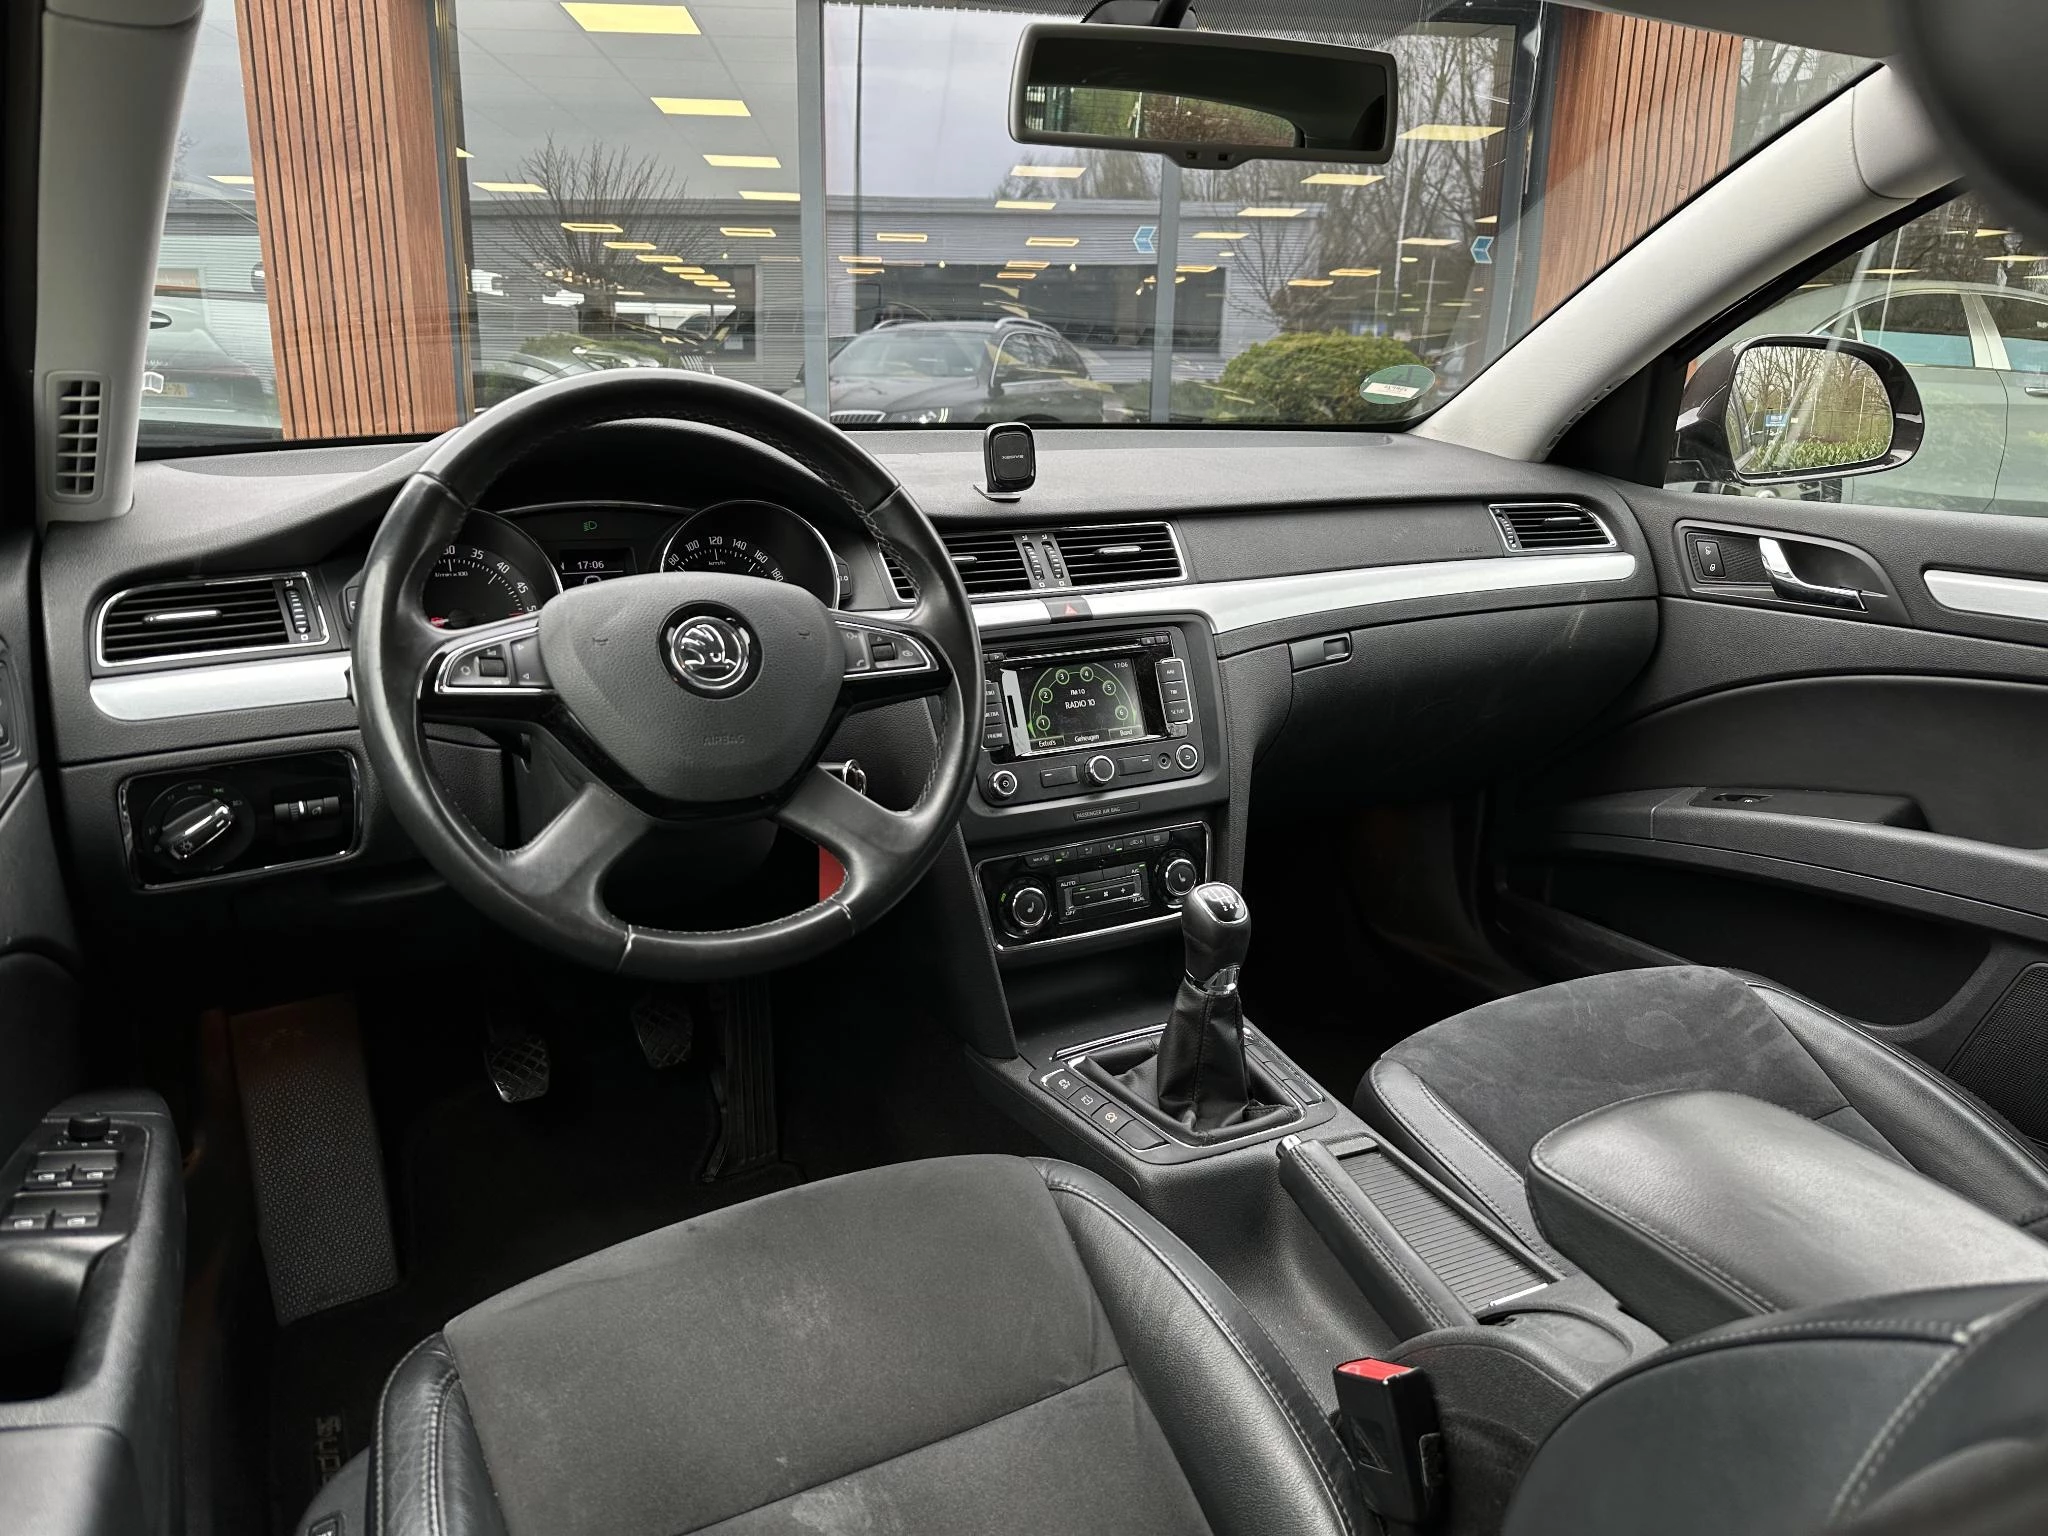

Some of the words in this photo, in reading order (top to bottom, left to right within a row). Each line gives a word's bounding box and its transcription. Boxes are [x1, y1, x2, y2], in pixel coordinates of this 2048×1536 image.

[684, 539, 700, 552] 100
[708, 536, 723, 545] 120
[732, 538, 747, 551] 140
[471, 548, 485, 560] 35
[668, 554, 680, 566] 80
[753, 549, 769, 564] 160
[496, 561, 511, 574] 40
[577, 560, 605, 570] 17:06
[770, 567, 784, 583] 180
[516, 581, 529, 595] 45
[1065, 699, 1087, 709] RADIO
[1076, 809, 1102, 819] PASSENGER
[1060, 880, 1076, 888] AUTO
